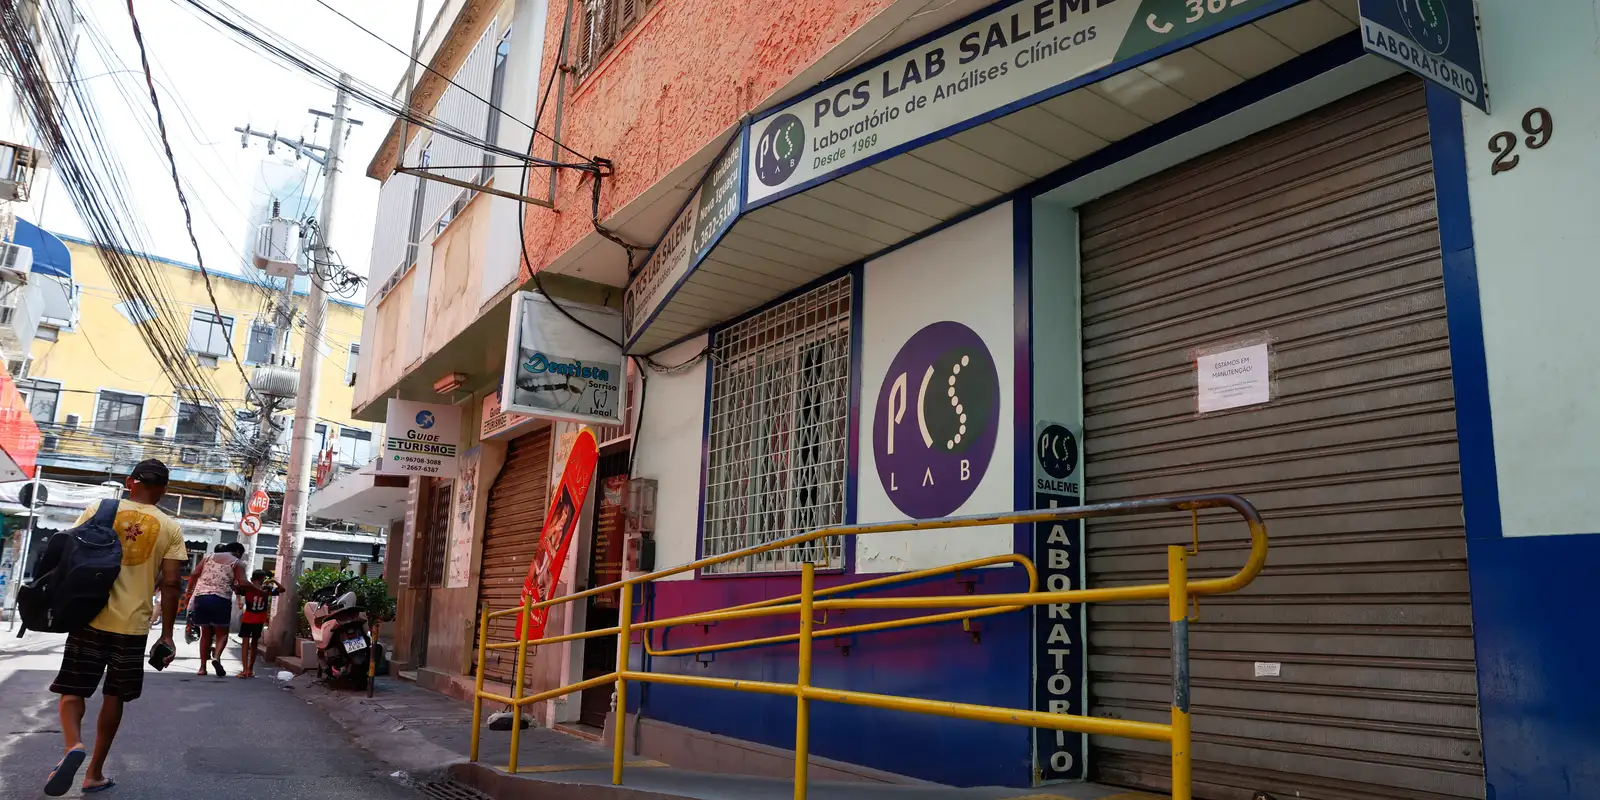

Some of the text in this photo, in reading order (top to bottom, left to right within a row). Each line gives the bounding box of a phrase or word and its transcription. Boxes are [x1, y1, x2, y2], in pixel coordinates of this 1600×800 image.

[1365, 25, 1475, 96] LABORATÓRIO
[813, 80, 870, 128] PCS
[882, 48, 946, 98] LAB
[813, 25, 1097, 152] Laboratório de Análises Clínicas
[760, 121, 795, 168] PCS
[813, 133, 878, 170] Desde 1969
[1488, 107, 1553, 176] 29
[713, 147, 739, 187] Unidade
[700, 167, 738, 223] Nova Iguaçu
[700, 193, 737, 248] 3622-5100
[635, 272, 647, 300] PCS
[650, 252, 660, 284] LAB
[661, 208, 692, 265] SALEME
[523, 353, 609, 381] Dentista
[1214, 359, 1240, 370] ESTAMOS
[588, 380, 617, 392] Sorriso
[888, 355, 969, 454] PCS
[589, 407, 612, 417] Legal
[397, 441, 448, 454] TURISMO
[407, 429, 440, 442] GUIDE
[1042, 433, 1070, 461] PCS
[1037, 479, 1079, 494] SALEME
